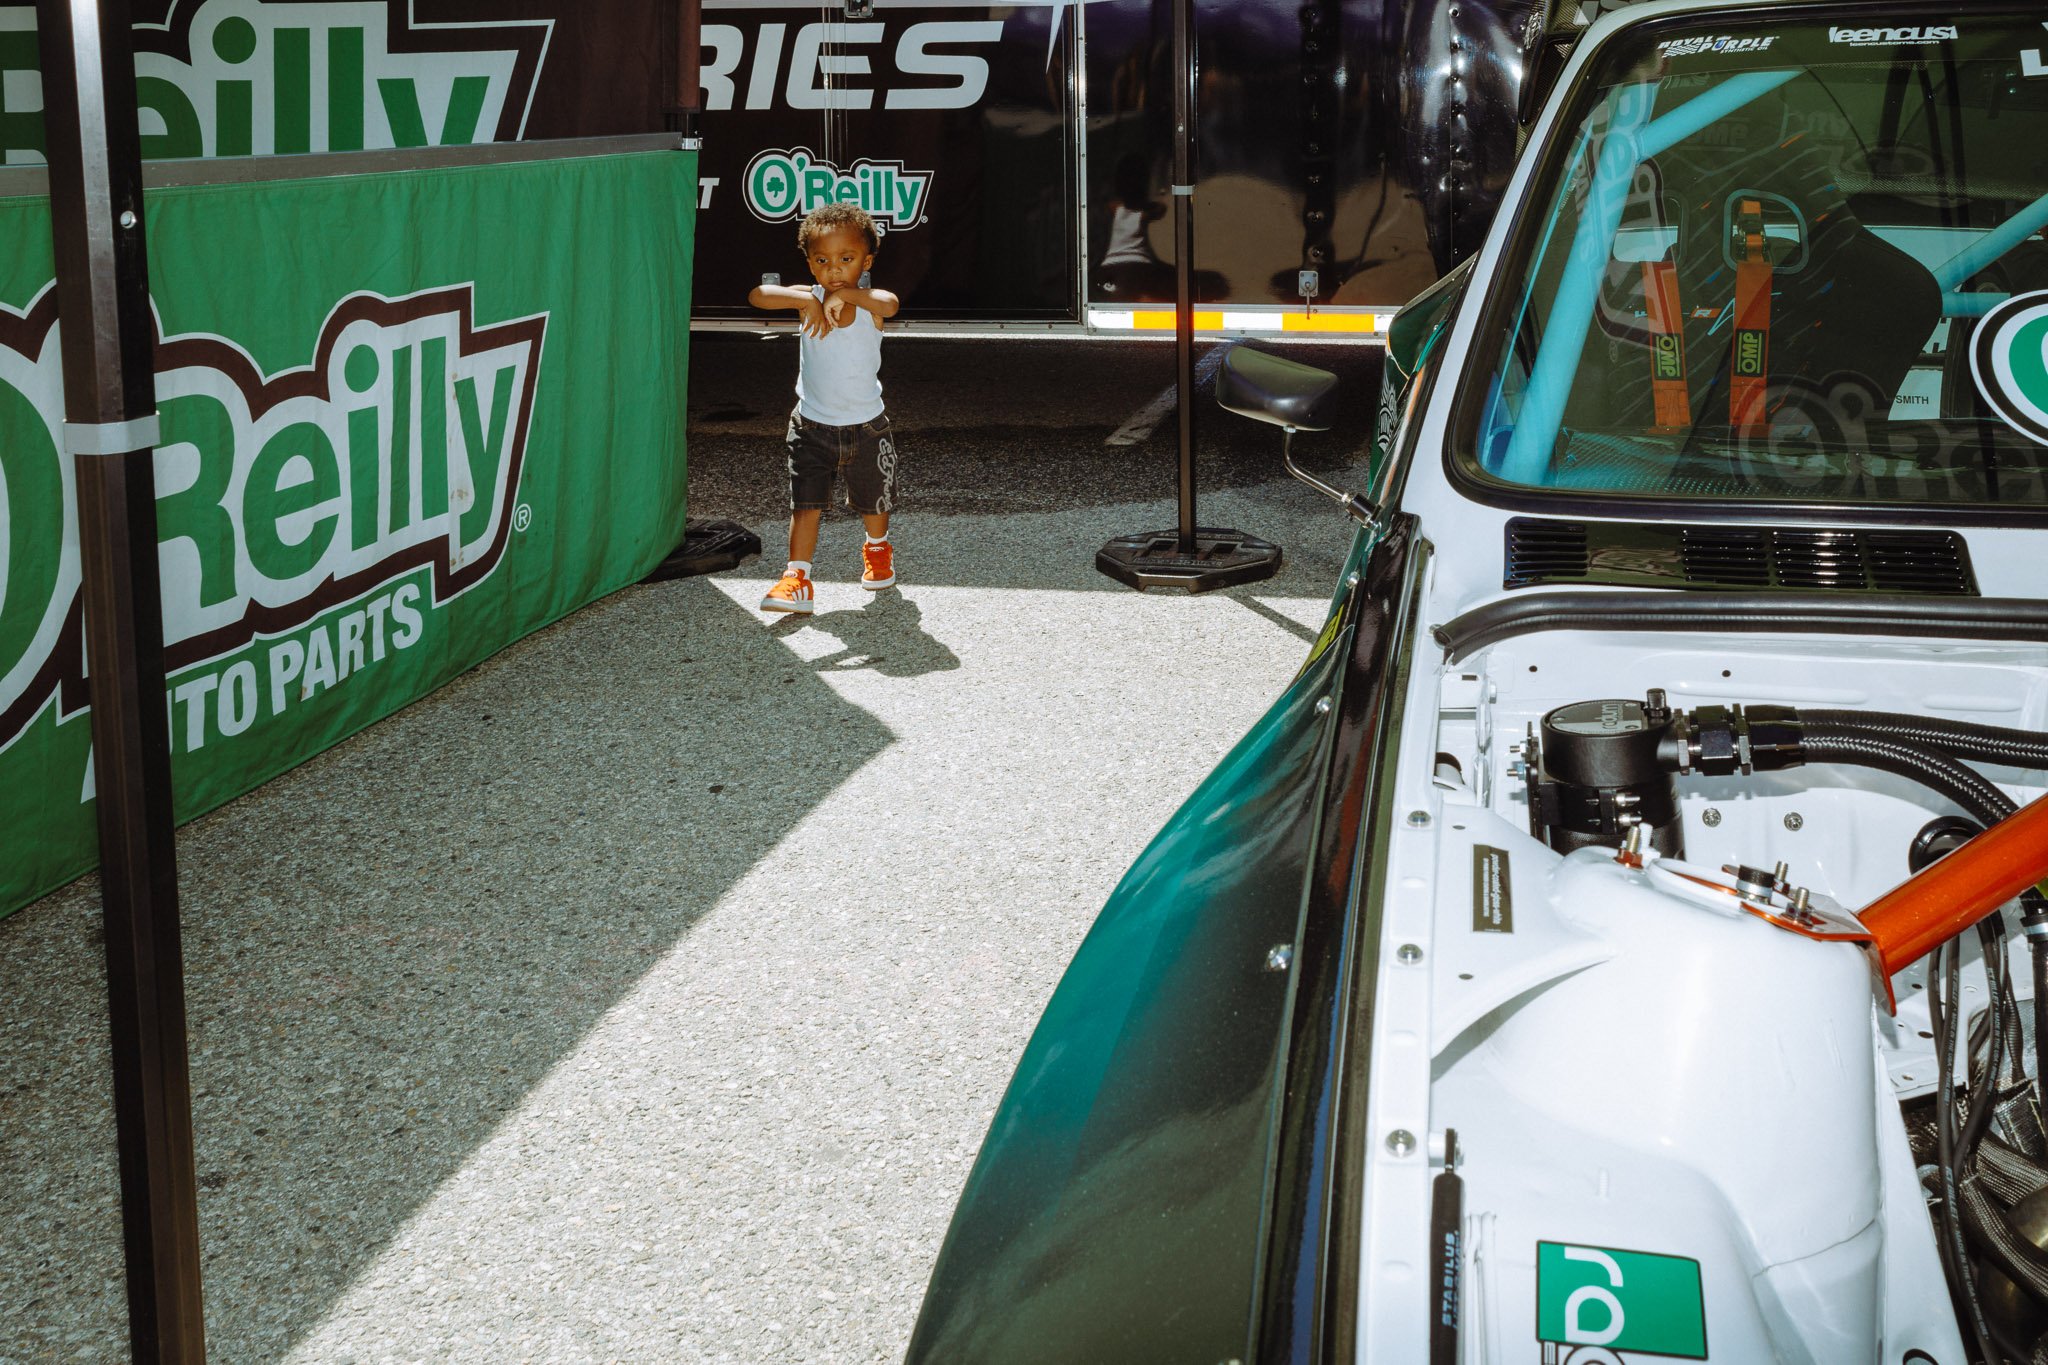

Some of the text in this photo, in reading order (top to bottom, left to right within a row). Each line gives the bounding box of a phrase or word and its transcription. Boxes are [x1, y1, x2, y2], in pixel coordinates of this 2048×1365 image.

[1698, 36, 1775, 53] PURPLE
[753, 157, 921, 222] O'Reilly
[1660, 335, 1677, 377] OMP
[1741, 332, 1758, 374] OMP
[1895, 395, 1929, 405] SMITH
[270, 583, 424, 716] PARTS
[1442, 1233, 1456, 1326] STABILUS
